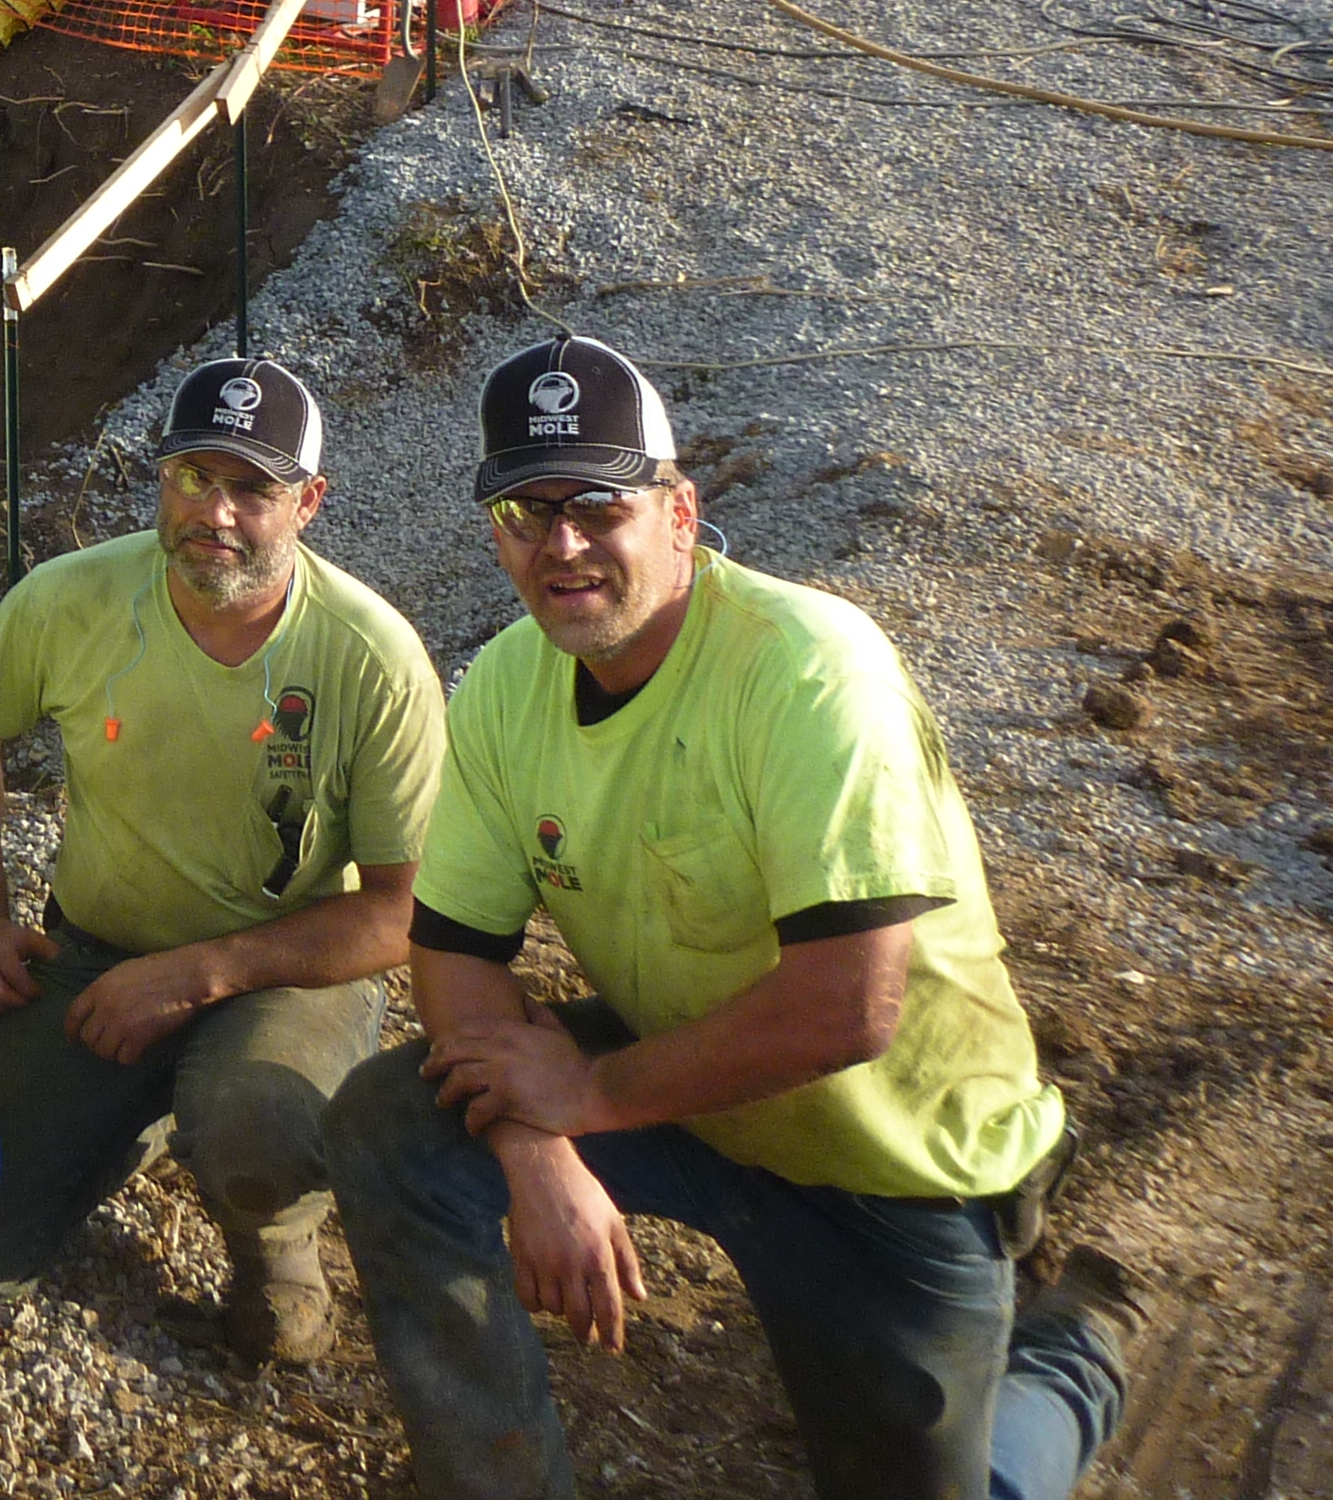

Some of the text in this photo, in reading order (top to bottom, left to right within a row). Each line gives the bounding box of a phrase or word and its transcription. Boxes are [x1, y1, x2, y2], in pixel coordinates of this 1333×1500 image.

[212, 413, 254, 431] MOLE
[528, 414, 580, 424] MIDWEST
[528, 422, 580, 437] MOLE
[535, 867, 583, 892] MOLE
